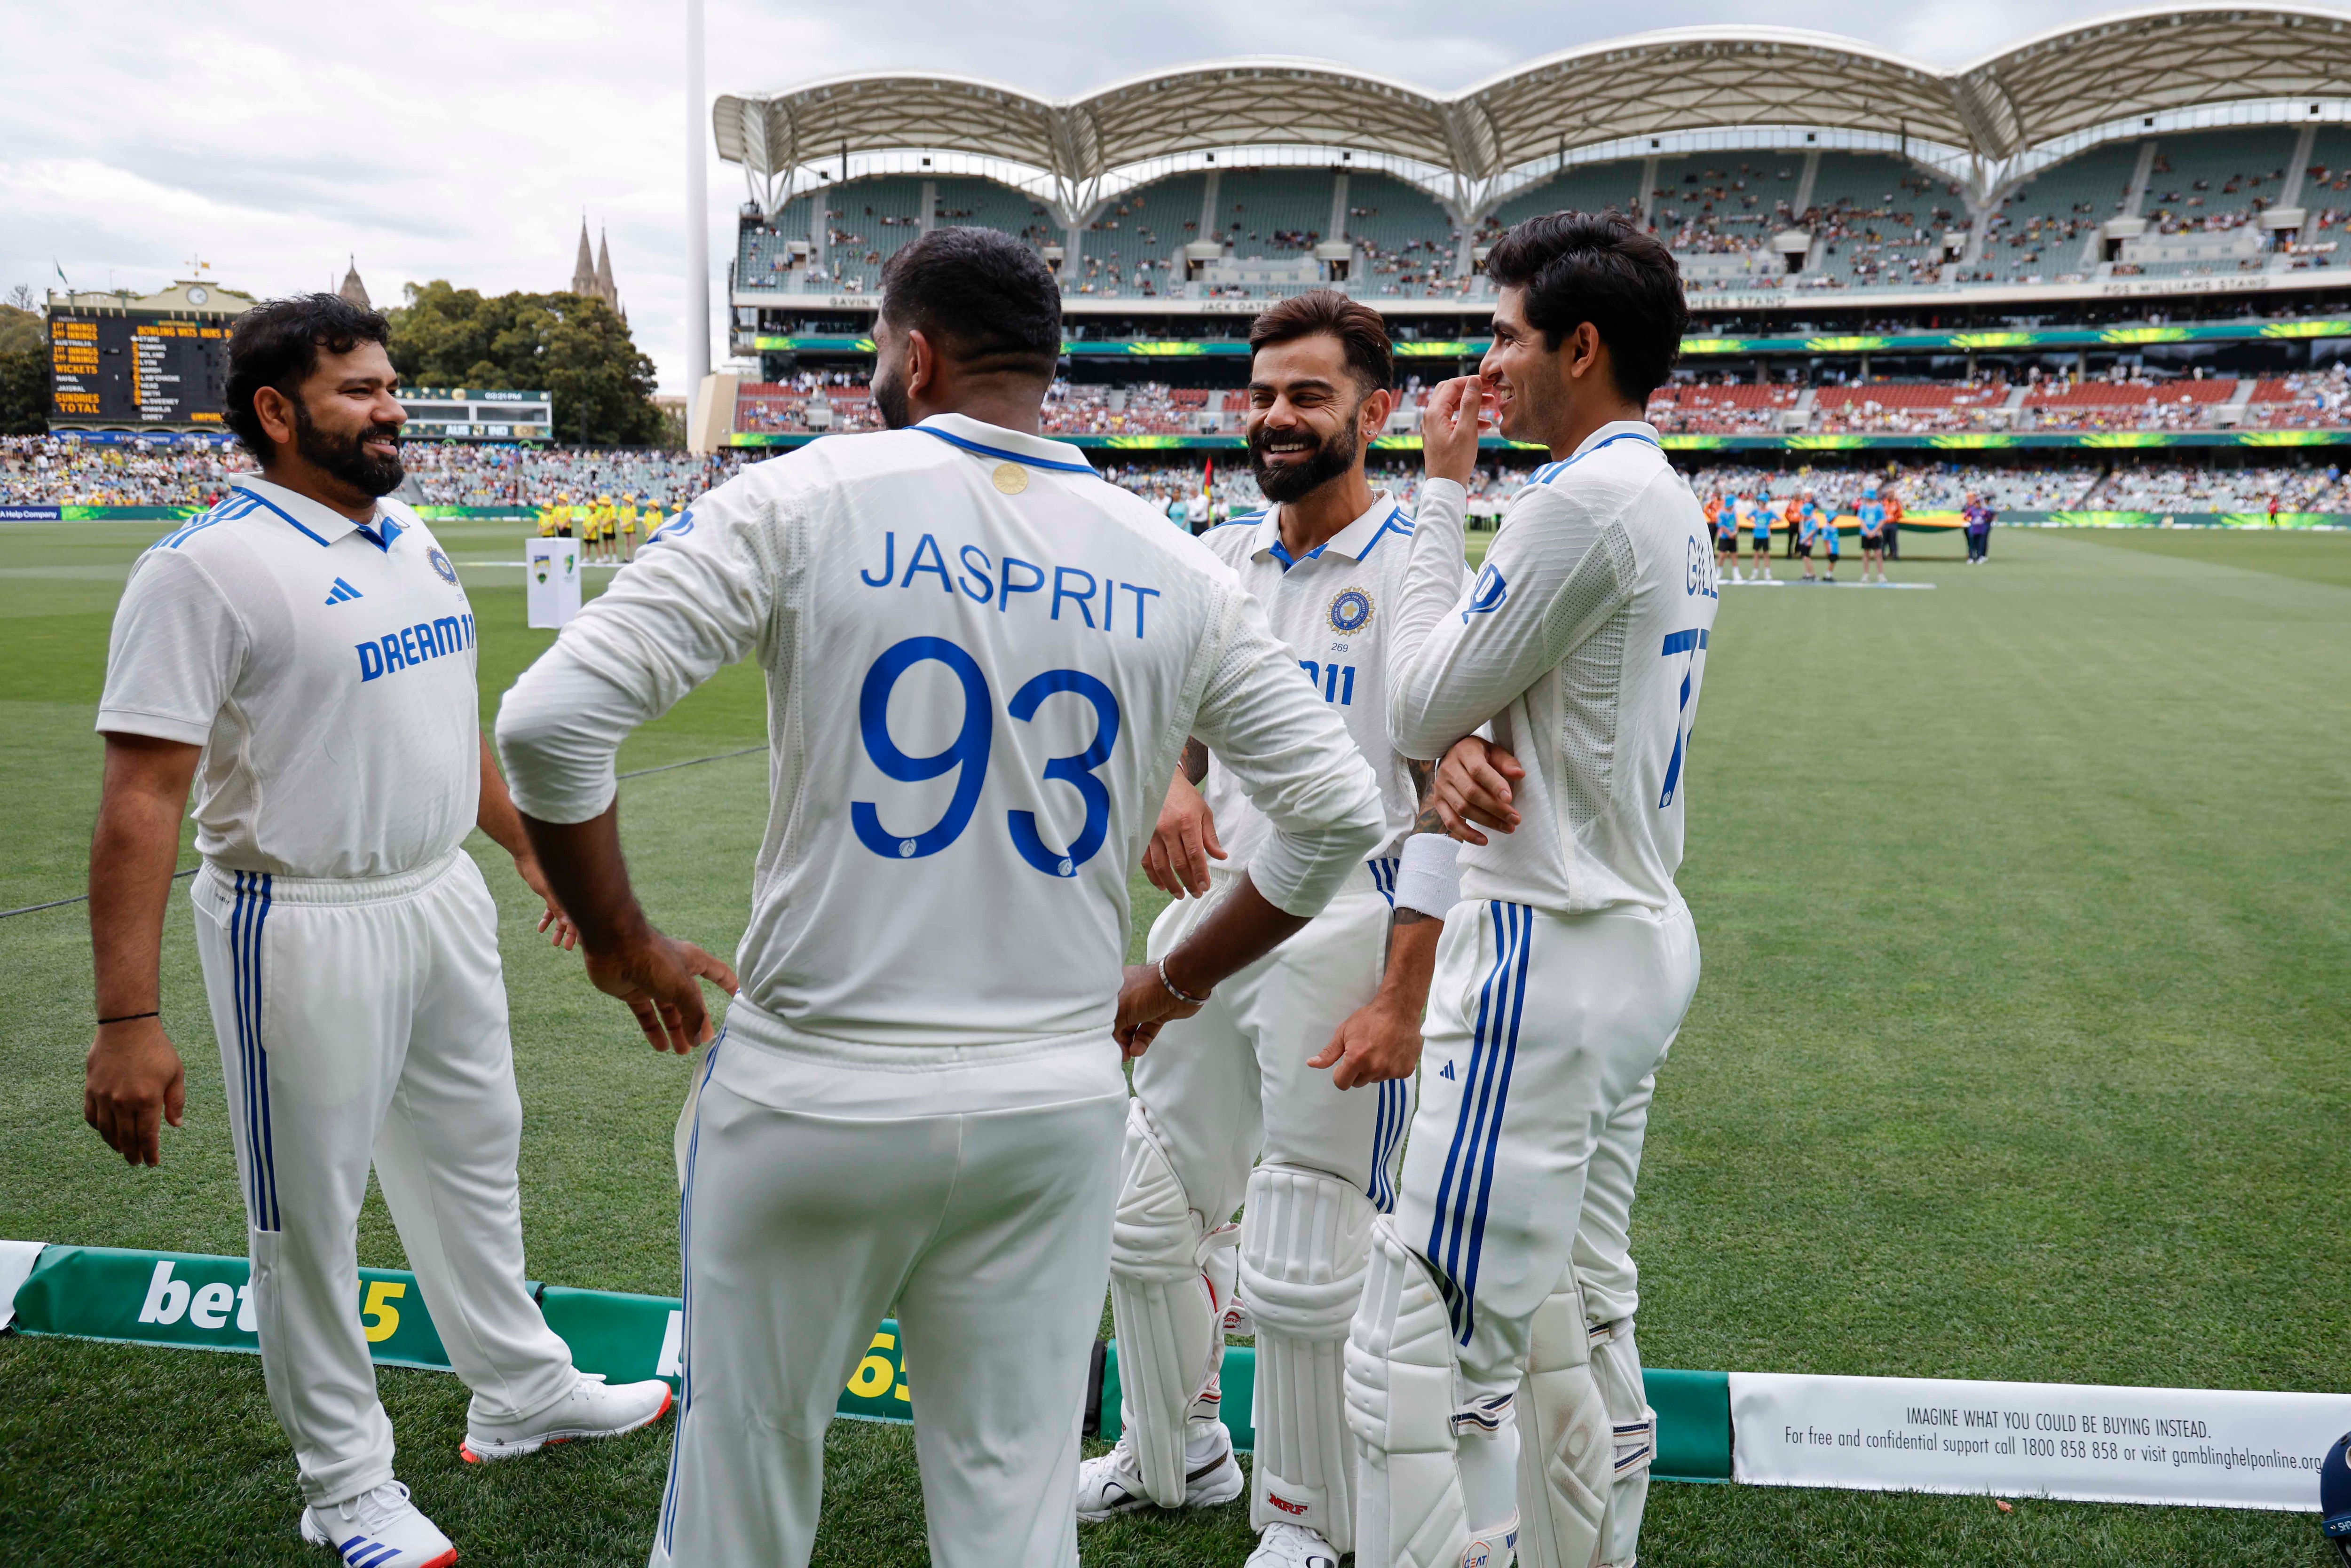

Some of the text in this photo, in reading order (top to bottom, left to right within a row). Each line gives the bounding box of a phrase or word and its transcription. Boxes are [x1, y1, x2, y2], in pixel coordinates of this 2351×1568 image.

[66, 323, 97, 332] INNINGS
[67, 331, 98, 340] INNINGS
[68, 347, 98, 356] INNINGS
[68, 355, 99, 364] INNINGS
[55, 364, 98, 374] WICKETS
[54, 393, 100, 403] SUNDRIES
[59, 402, 100, 413] TOTAL
[446, 424, 508, 436] AUS IND
[6, 510, 23, 519] Help
[23, 510, 57, 519] Company
[1687, 535, 1717, 599] GILL
[860, 531, 1160, 638] JASPRIT
[354, 614, 474, 682] DREAM11
[1331, 643, 1348, 652] 269
[851, 636, 1120, 878] 93
[1908, 1407, 2211, 1438] IMAGINE WHAT YOU COULD BE BUYING INSTEAD.
[1786, 1426, 1803, 1443] For
[1809, 1426, 1832, 1445] free
[1838, 1428, 1860, 1446] and
[1867, 1430, 1937, 1450] confidential
[1943, 1439, 1989, 1456] support
[1995, 1436, 2015, 1454] call
[2022, 1438, 2054, 1457] 1800
[2061, 1440, 2086, 1458] 858
[2092, 1442, 2117, 1459] 858
[2124, 1449, 2136, 1460] or
[2141, 1445, 2166, 1462] visit
[1269, 1492, 1308, 1515] MRF
[1464, 1555, 1487, 1568] CEAT
